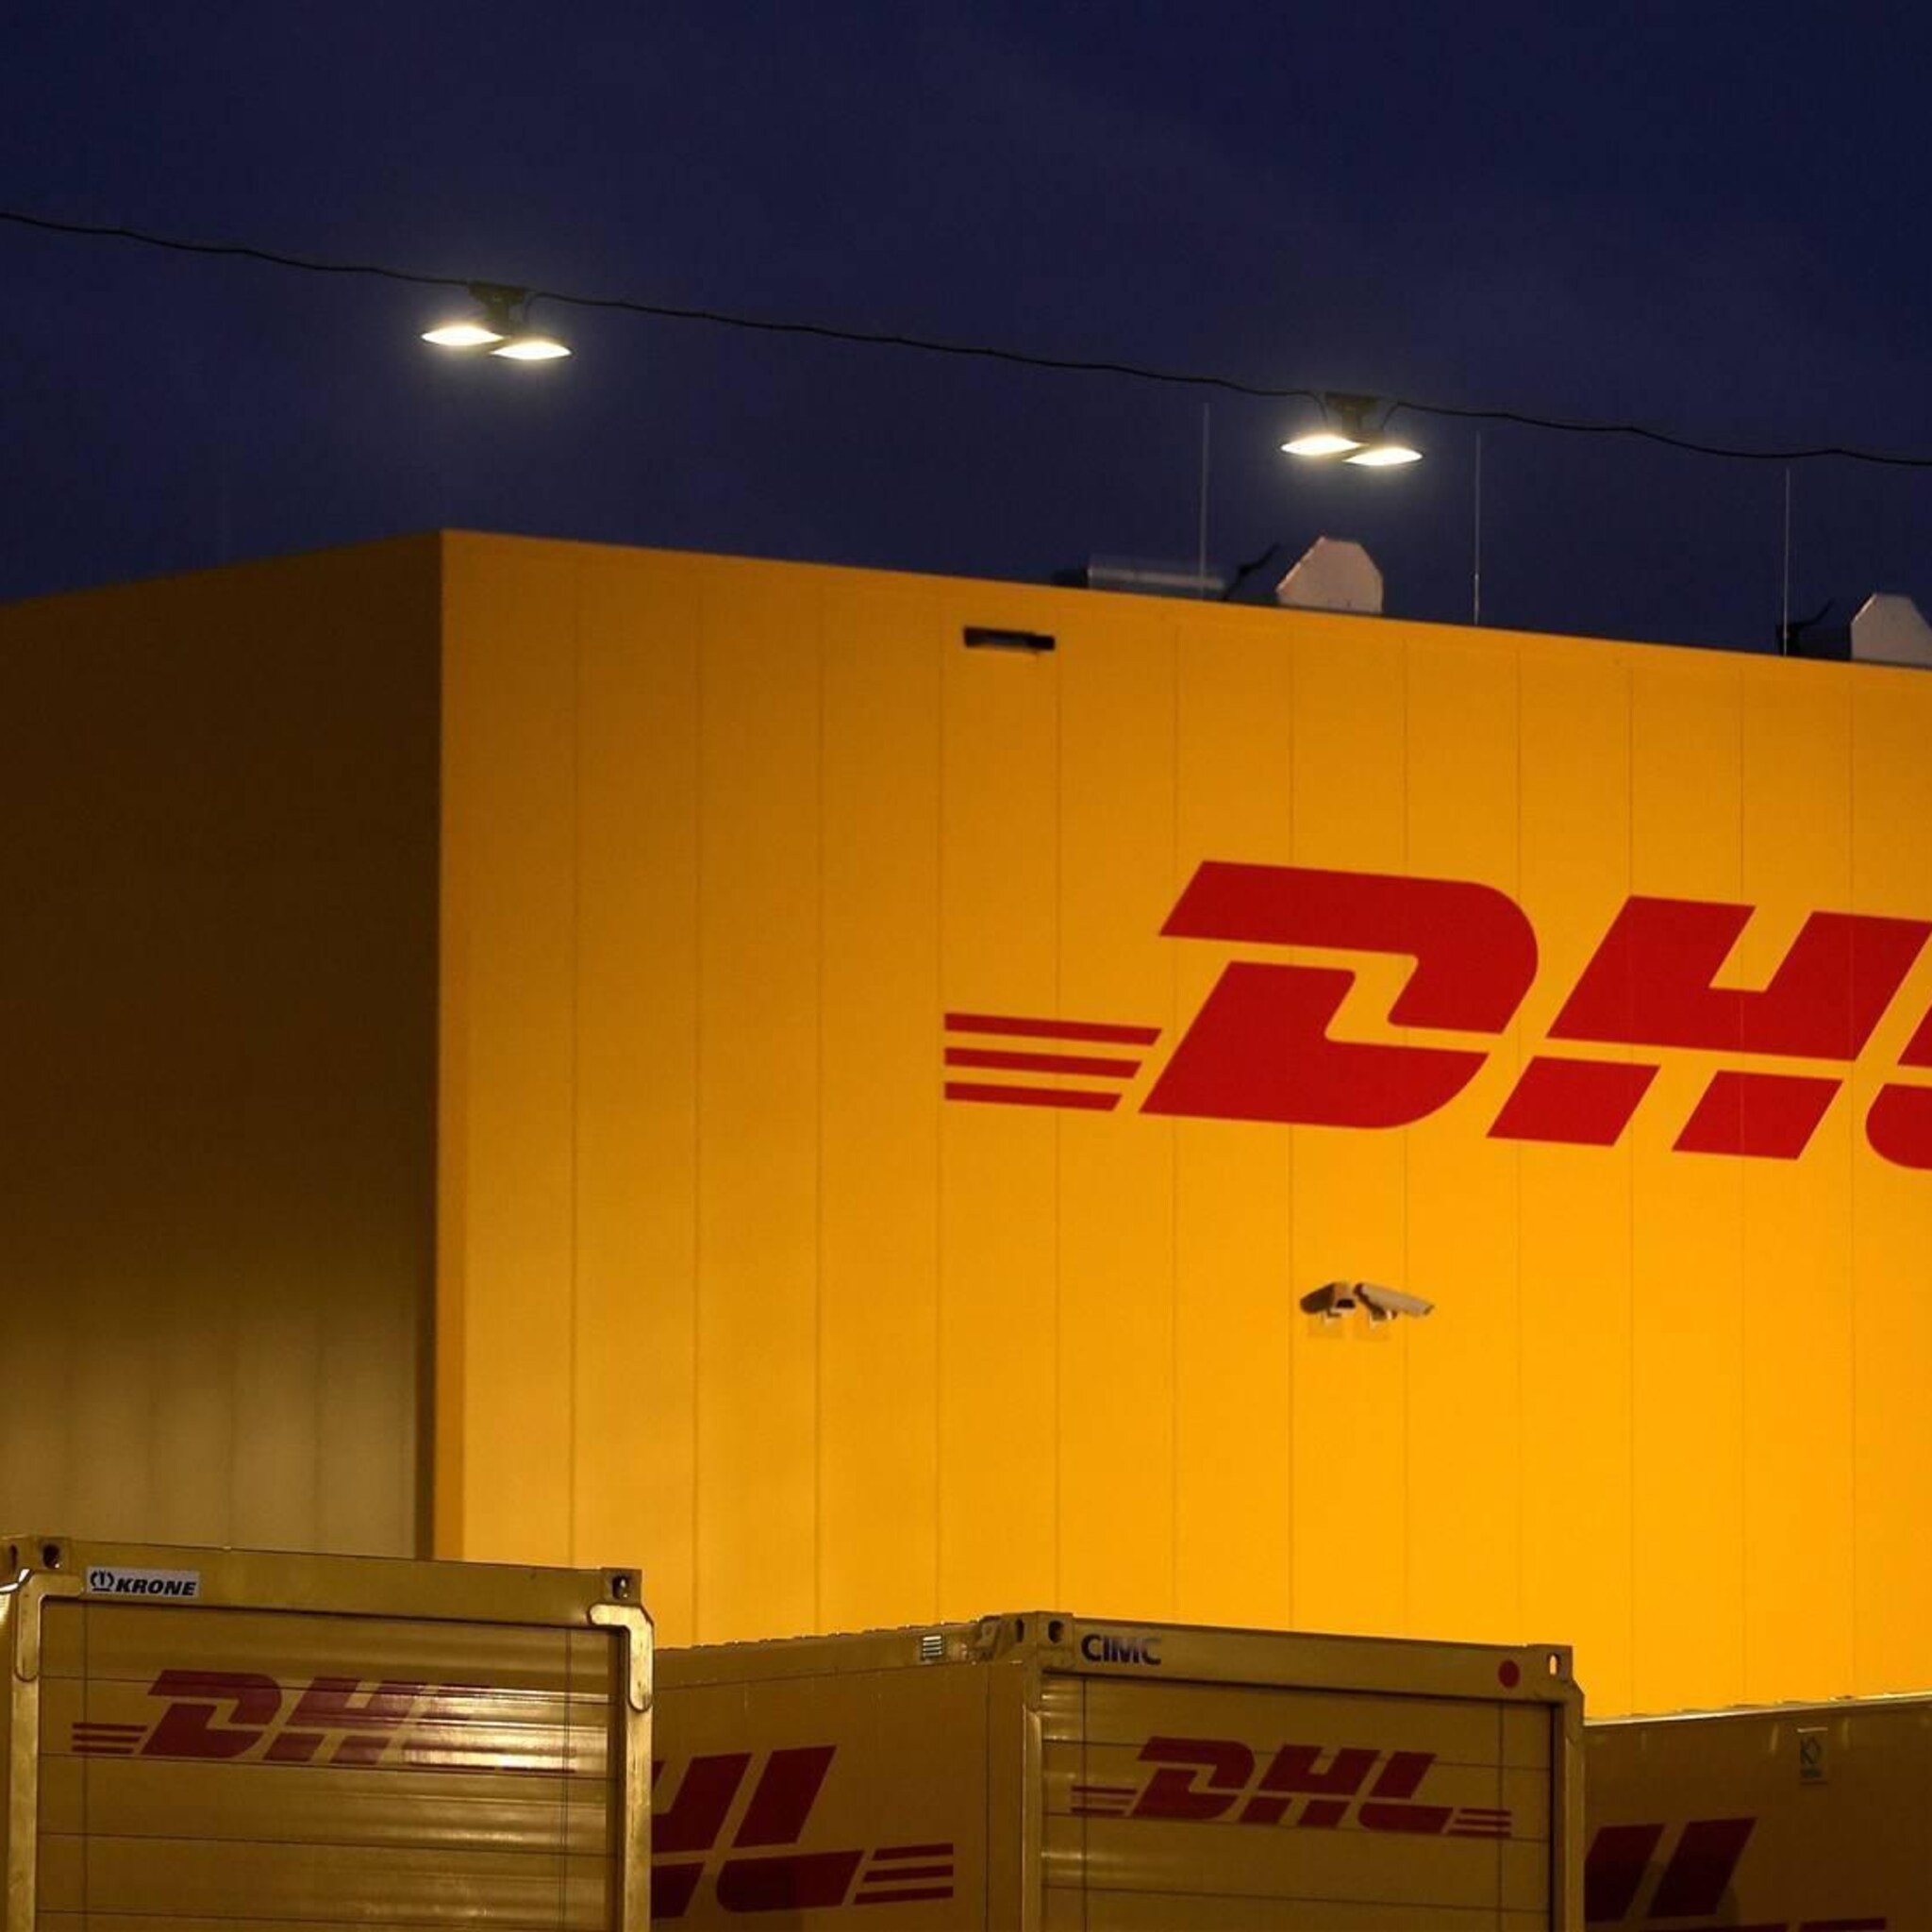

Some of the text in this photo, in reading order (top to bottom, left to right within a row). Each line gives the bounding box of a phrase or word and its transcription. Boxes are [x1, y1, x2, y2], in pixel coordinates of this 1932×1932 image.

[1139, 859, 1932, 1171] DH
[115, 1578, 196, 1596] KRONE
[1081, 1634, 1161, 1665] CIMC
[140, 1669, 496, 1772] DHL
[1132, 1736, 1454, 1834] DHL
